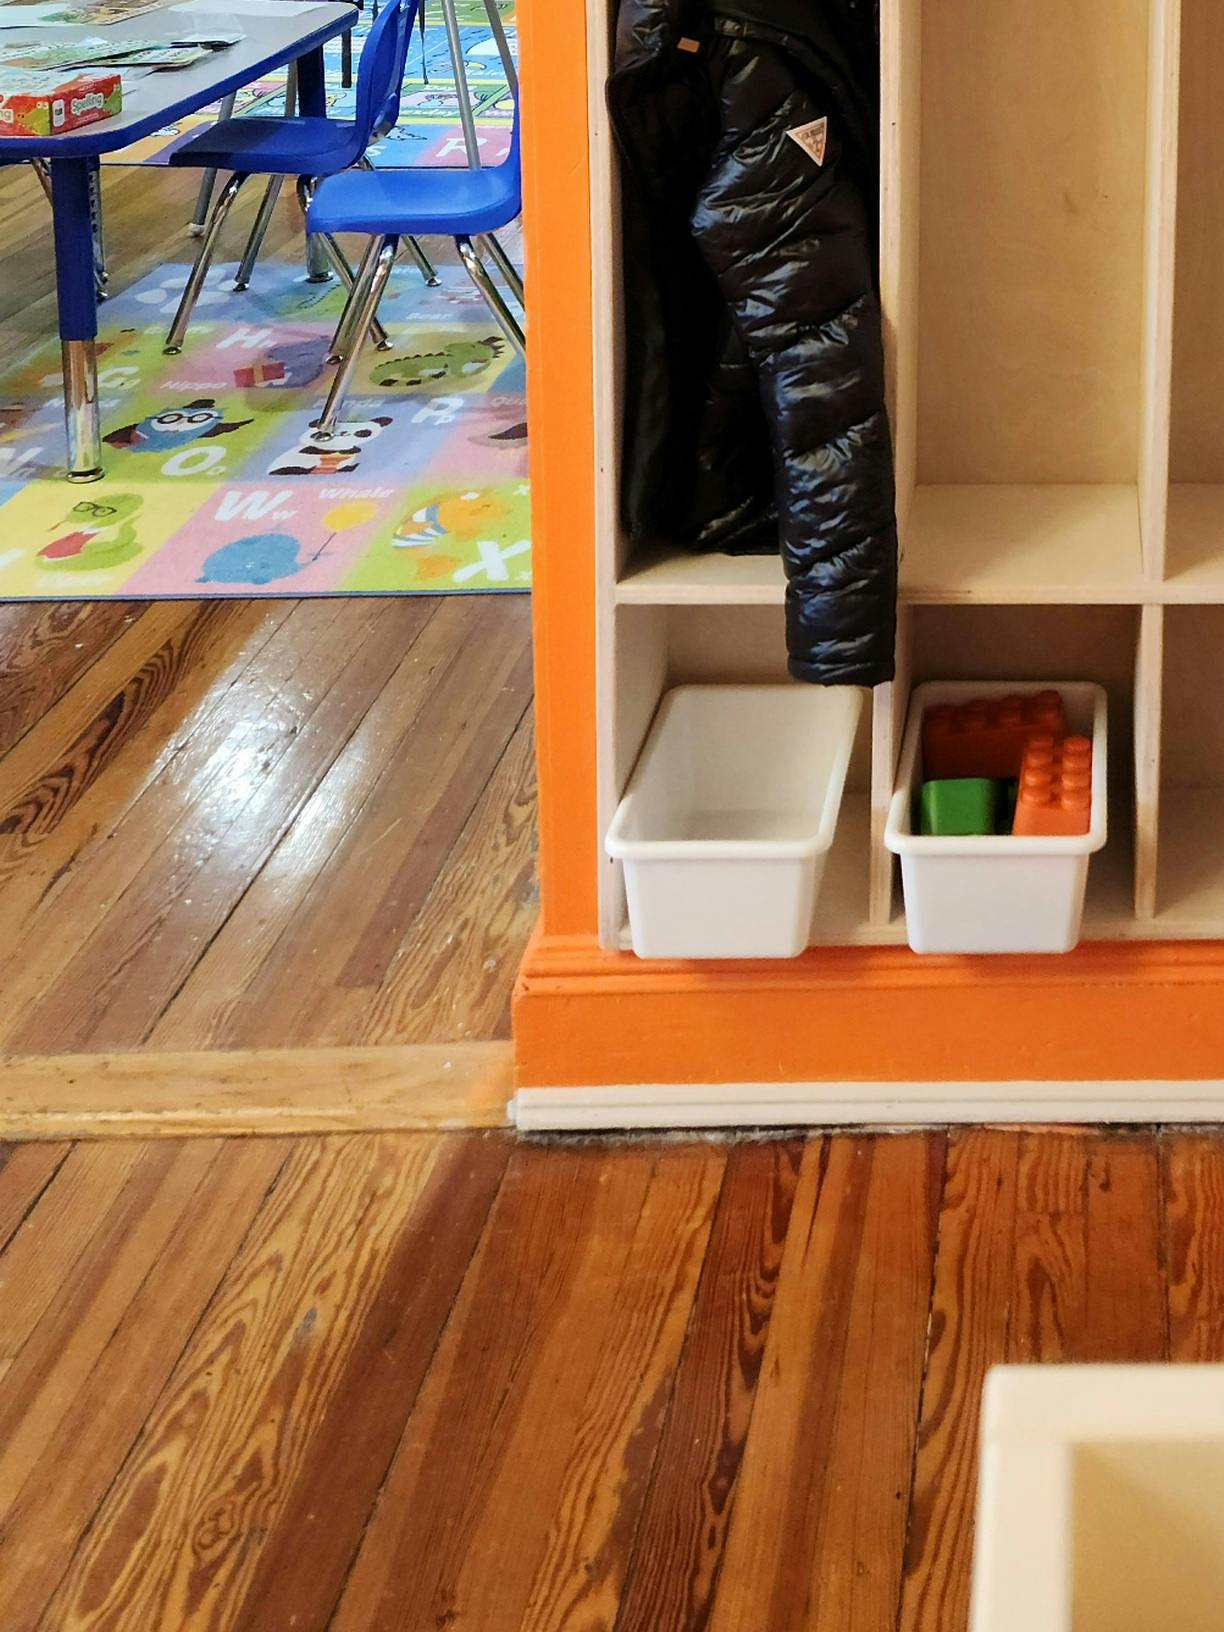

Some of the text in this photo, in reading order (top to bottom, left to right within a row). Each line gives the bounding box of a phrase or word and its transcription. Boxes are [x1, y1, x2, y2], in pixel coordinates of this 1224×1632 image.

[73, 94, 102, 112] Spelling
[311, 398, 384, 410] Pnda
[320, 487, 394, 499] Whale
